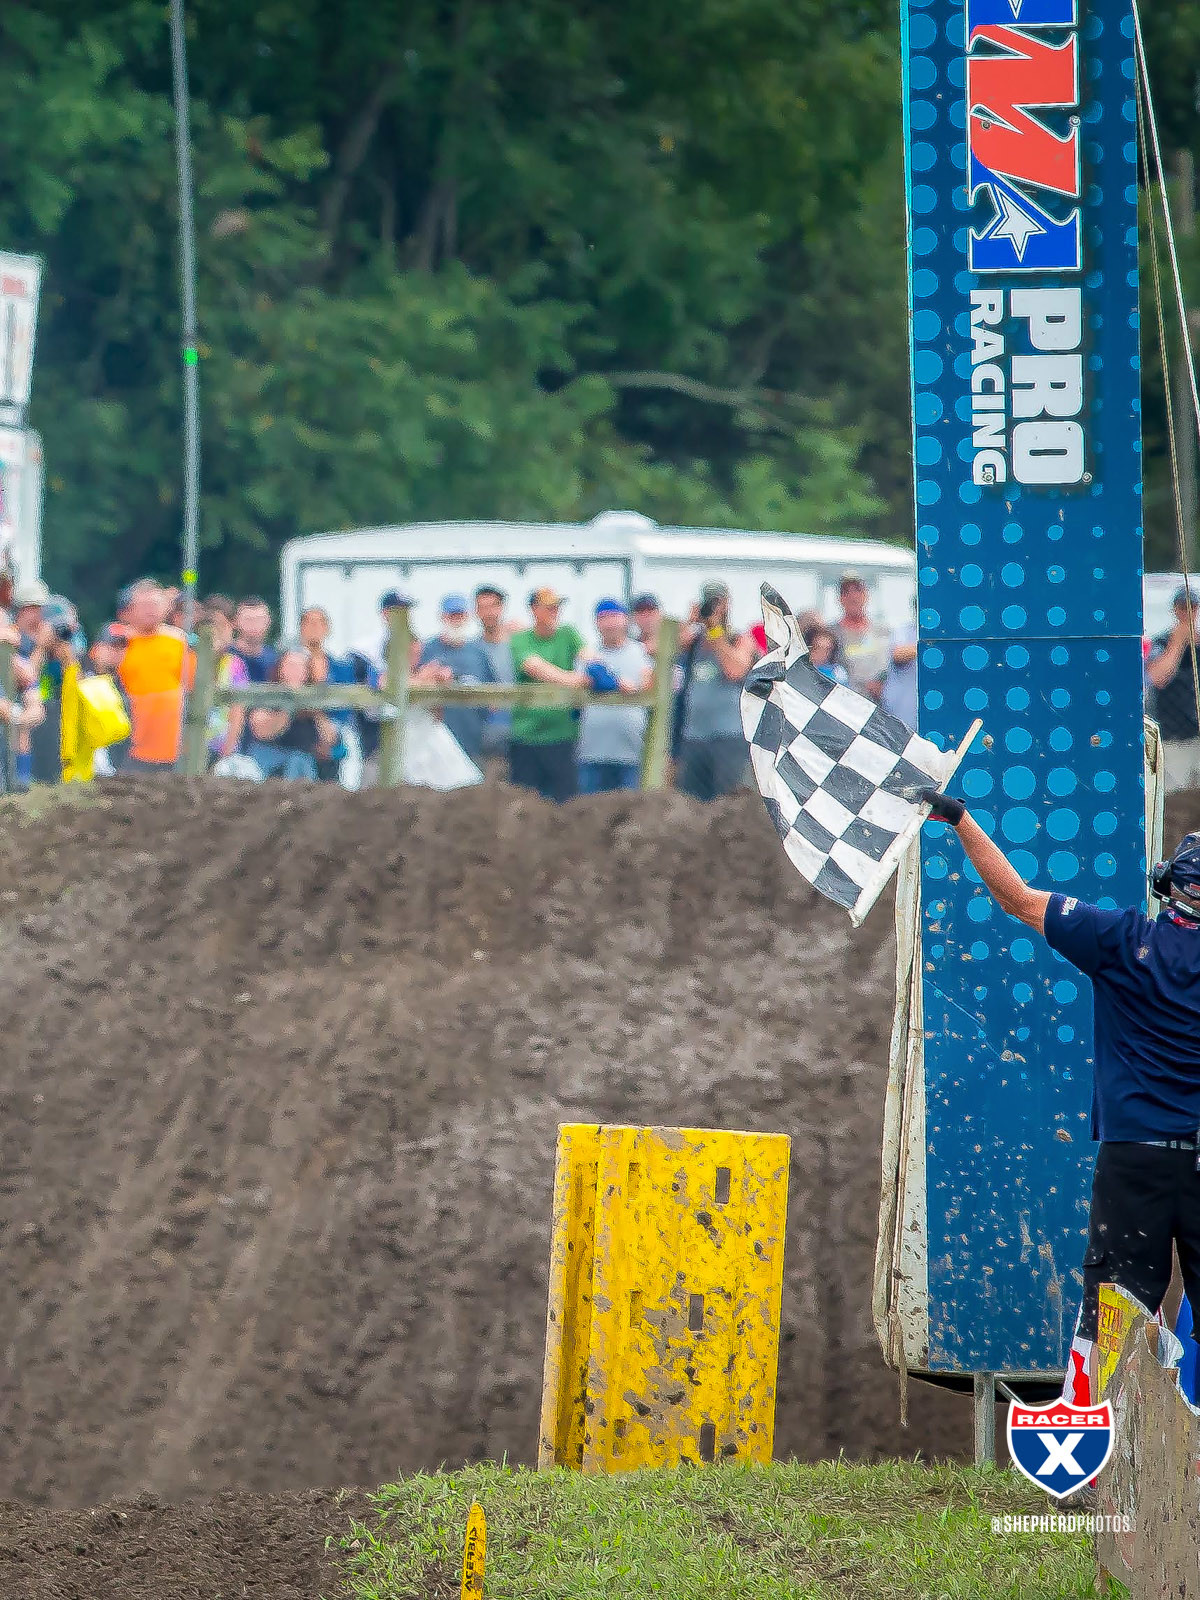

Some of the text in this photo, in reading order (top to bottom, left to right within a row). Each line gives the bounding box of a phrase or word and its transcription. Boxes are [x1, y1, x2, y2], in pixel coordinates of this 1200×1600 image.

[966, 0, 1082, 271] MA
[969, 289, 1007, 485] RACING
[1010, 287, 1085, 484] PRO
